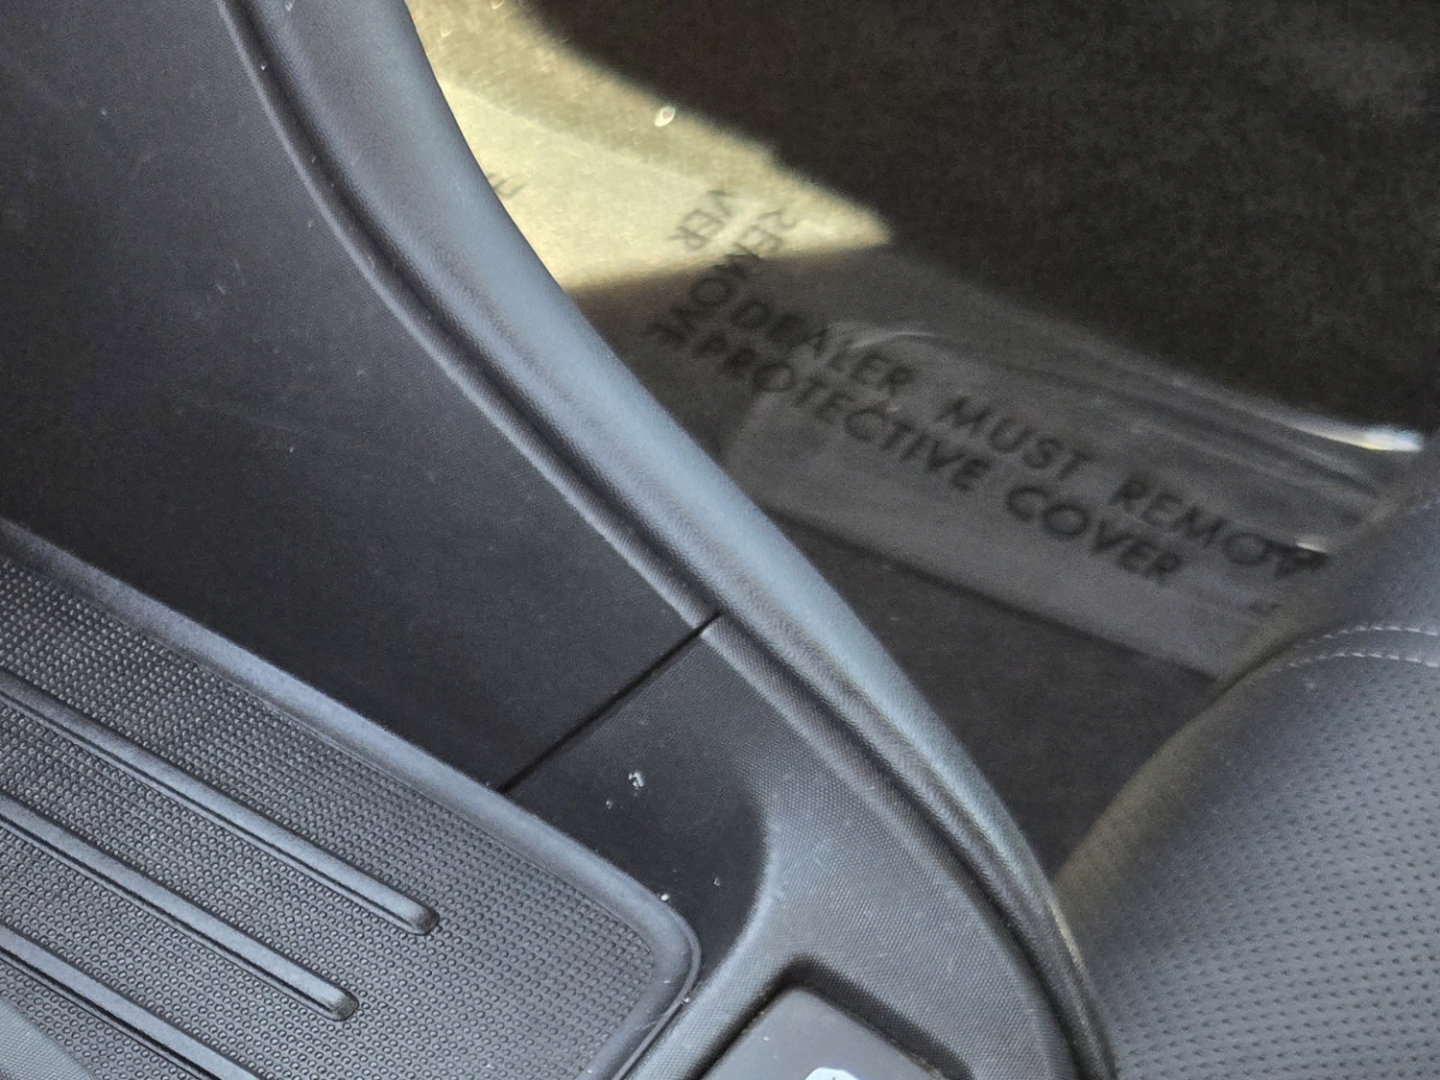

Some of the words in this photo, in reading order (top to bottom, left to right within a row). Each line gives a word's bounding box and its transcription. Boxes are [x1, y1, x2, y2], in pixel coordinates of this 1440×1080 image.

[692, 330, 992, 492] PROTECTIVE
[1004, 484, 1184, 585] COVER
[728, 298, 914, 397] DEALER
[934, 393, 1092, 480] MUST
